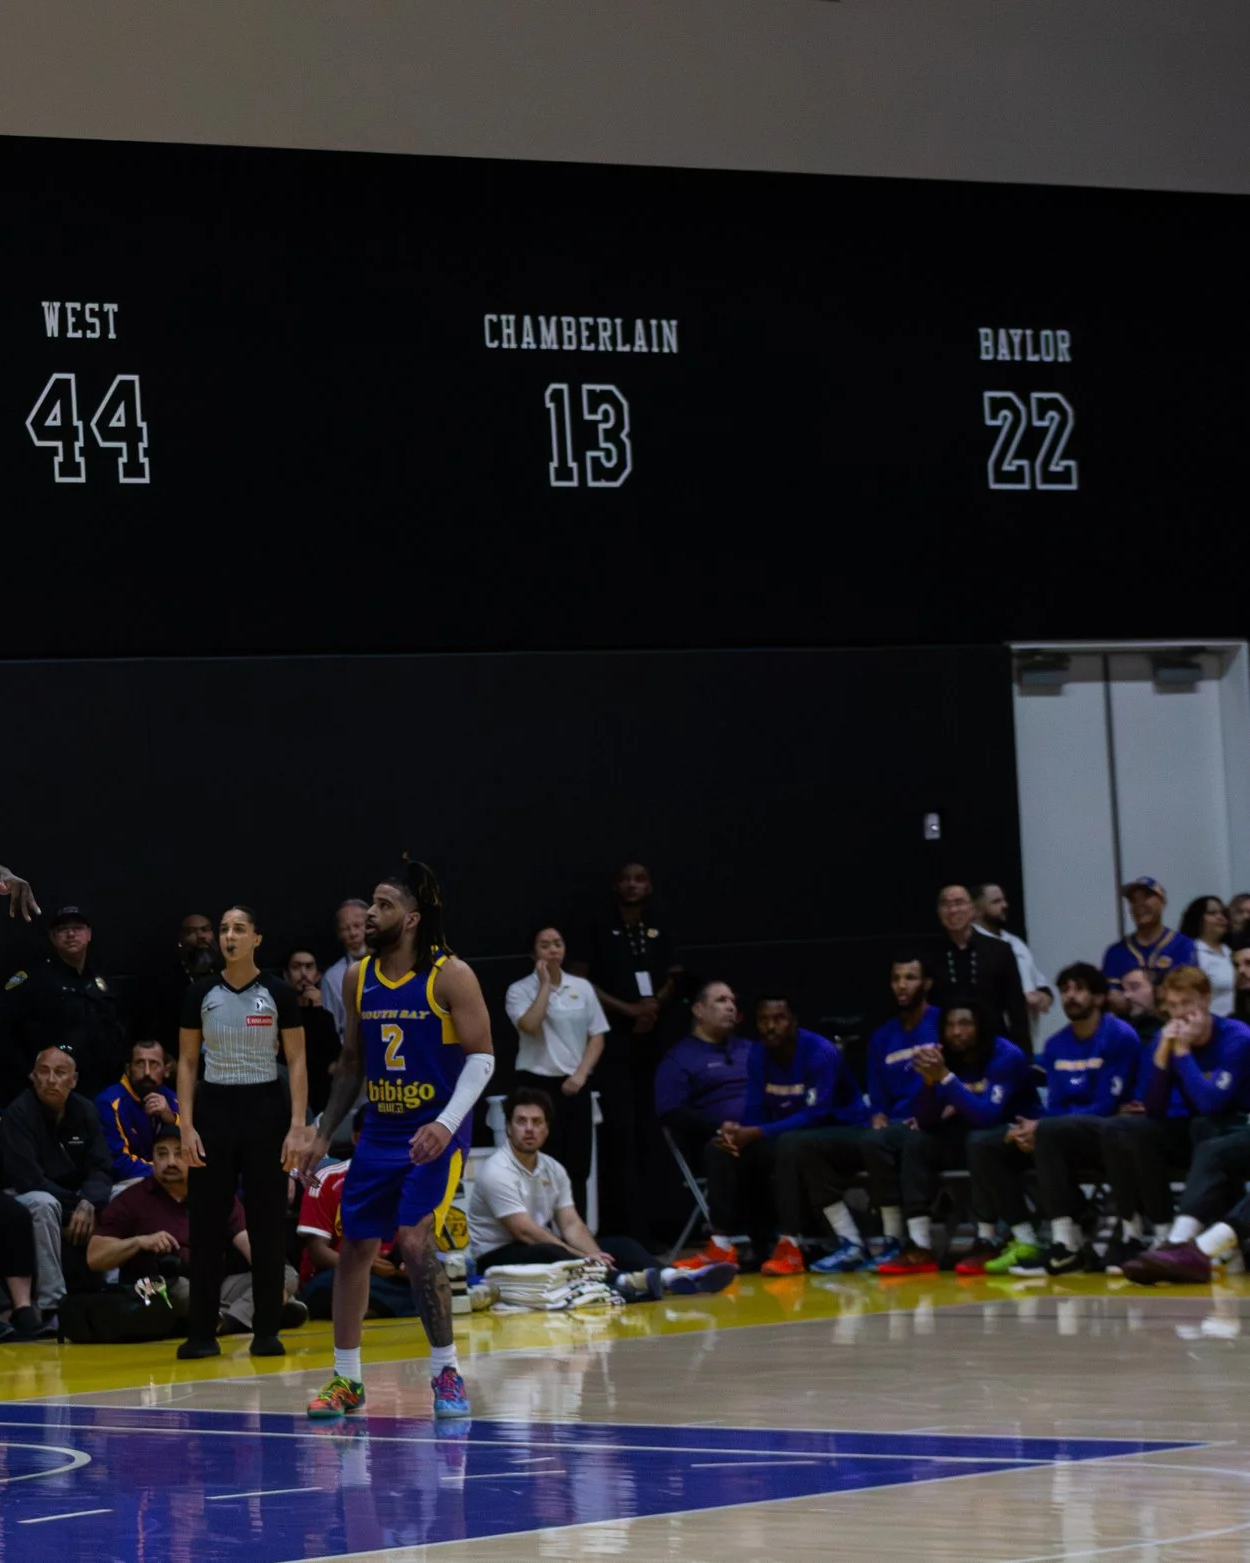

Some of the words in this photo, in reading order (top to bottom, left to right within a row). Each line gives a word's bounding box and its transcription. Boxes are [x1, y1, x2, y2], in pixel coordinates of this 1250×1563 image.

[41, 300, 119, 340] WEST
[483, 314, 679, 354] CHAMBERLAIN
[978, 327, 1072, 363] BAYLOR
[25, 373, 151, 484] 44
[544, 383, 633, 488] 13
[982, 390, 1079, 491] 22
[381, 1024, 406, 1071] 2
[368, 1078, 436, 1109] bibigo
